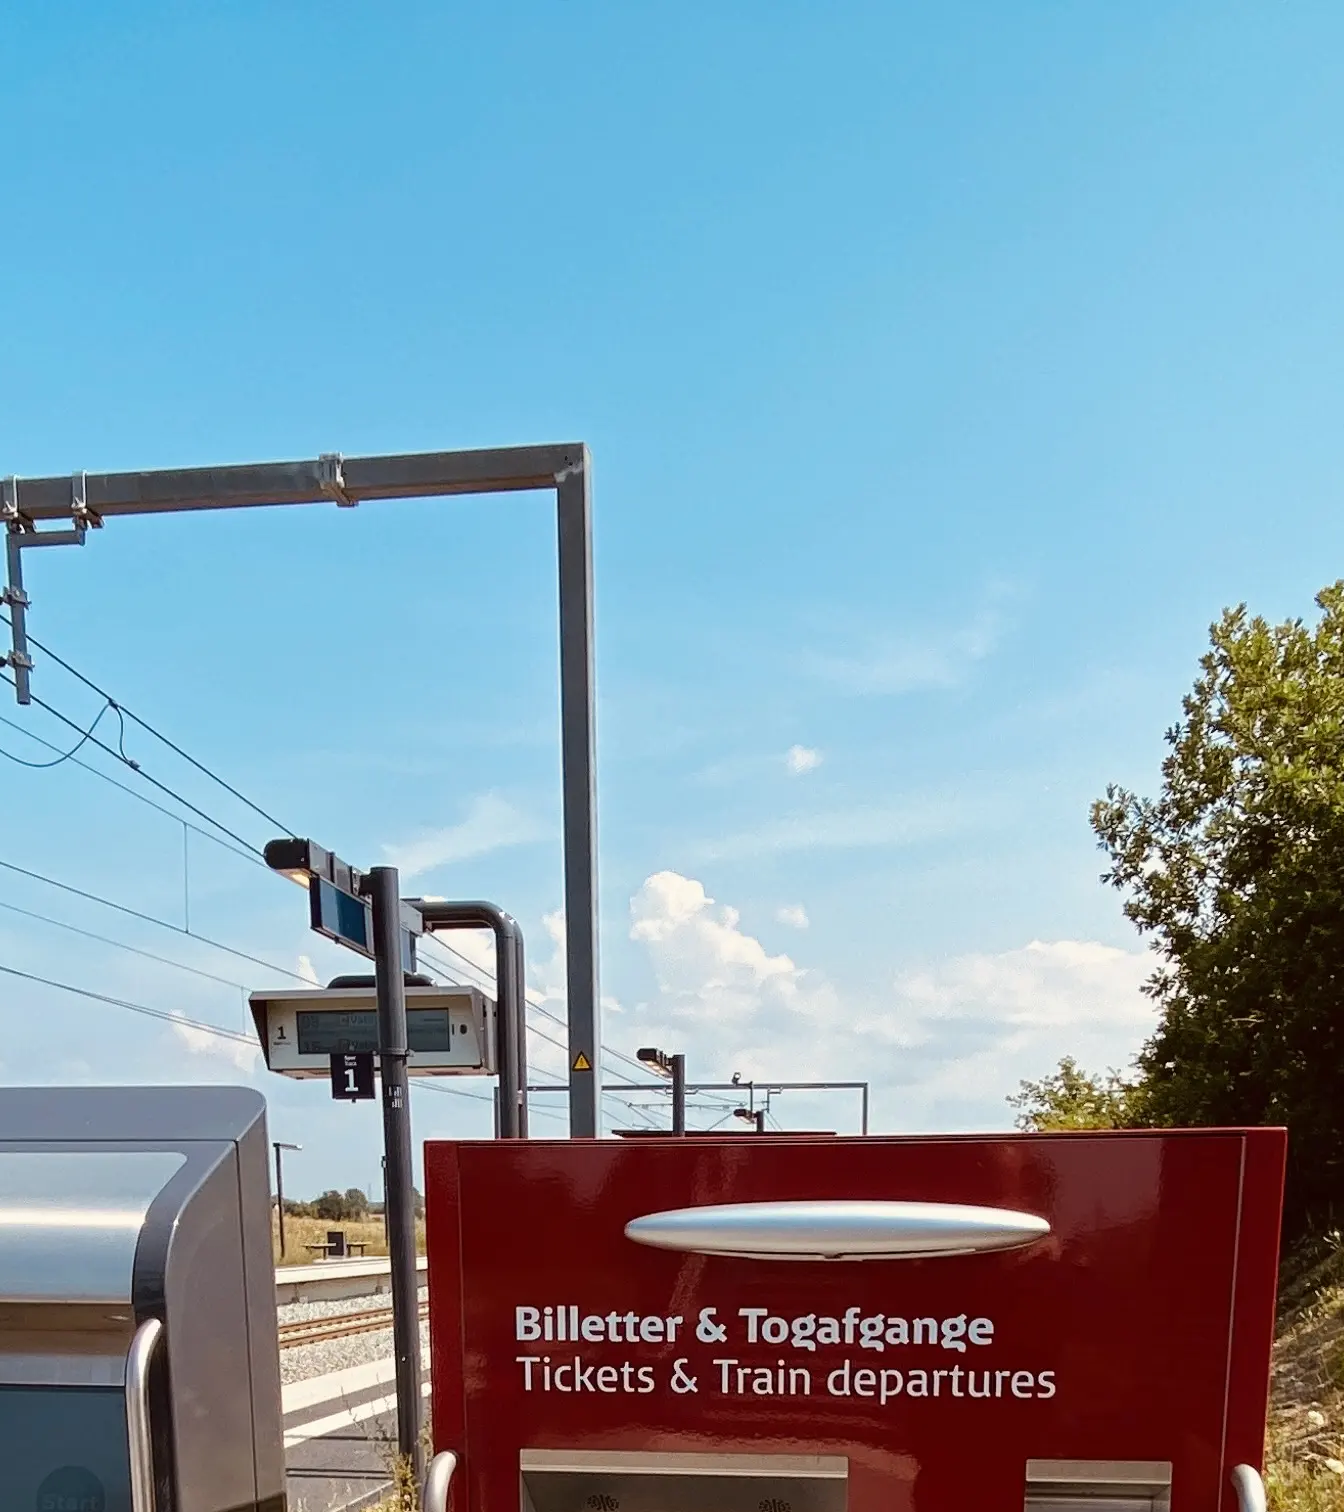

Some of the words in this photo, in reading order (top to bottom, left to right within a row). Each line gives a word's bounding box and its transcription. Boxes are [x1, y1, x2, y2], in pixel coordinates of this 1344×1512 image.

[344, 1068, 359, 1092] 1
[515, 1305, 684, 1343] Billetter
[695, 1307, 728, 1343] &
[738, 1307, 995, 1353] Togafgange
[515, 1356, 655, 1393] Tickets
[670, 1358, 699, 1394] &
[712, 1359, 811, 1395] Train
[826, 1359, 1056, 1405] departures
